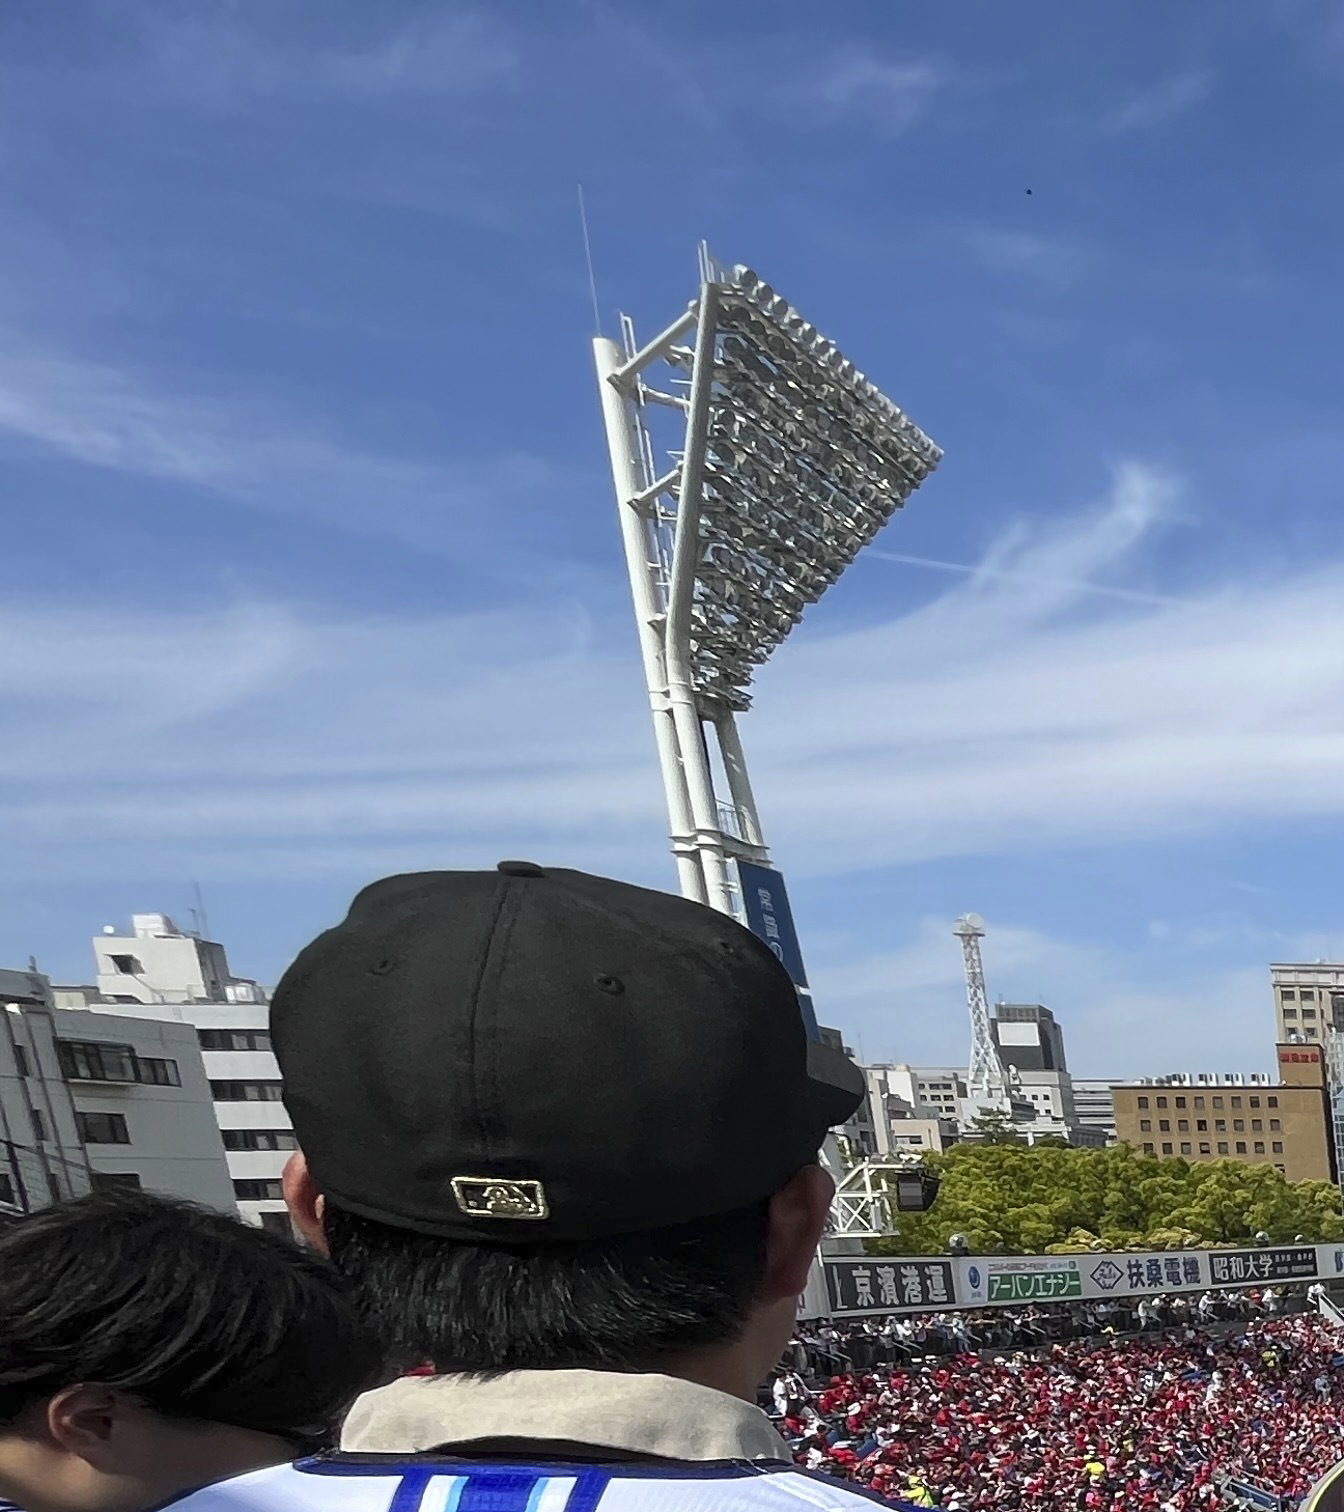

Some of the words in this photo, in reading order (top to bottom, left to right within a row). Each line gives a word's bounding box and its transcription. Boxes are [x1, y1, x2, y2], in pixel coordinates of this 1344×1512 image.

[1126, 1256, 1201, 1289] 扶桑電機
[1212, 1254, 1273, 1281] 昭和大学
